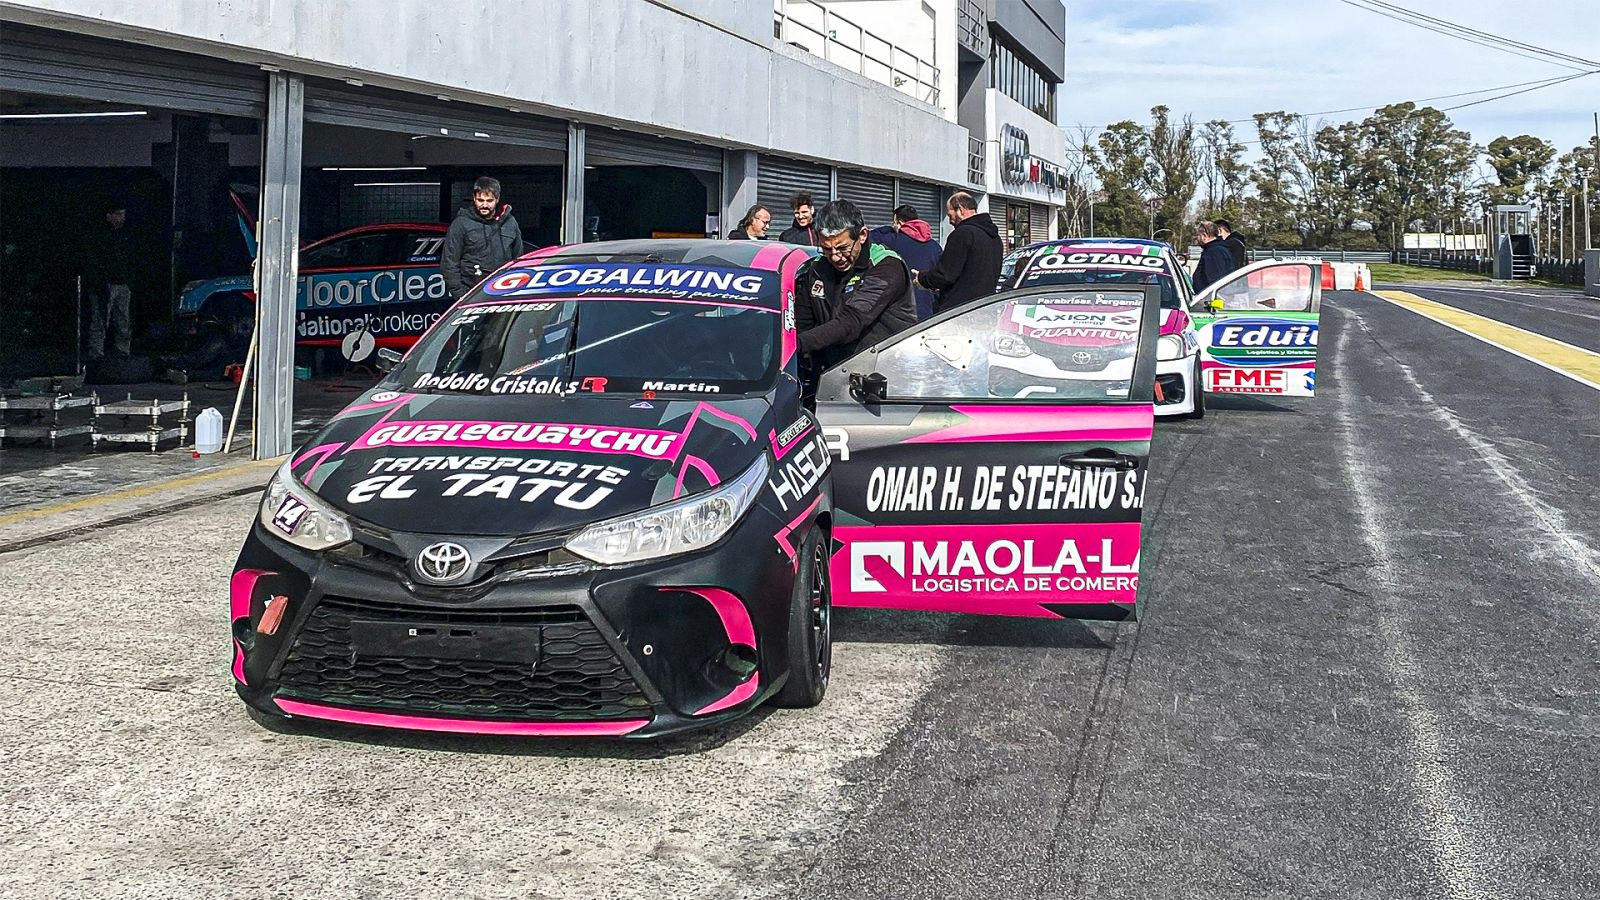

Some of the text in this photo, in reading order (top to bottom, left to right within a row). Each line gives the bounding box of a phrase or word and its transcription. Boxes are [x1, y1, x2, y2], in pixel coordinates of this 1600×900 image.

[412, 237, 444, 255] 77
[1038, 253, 1164, 269] OCTANO
[493, 267, 763, 293] GLOBALWING
[577, 286, 758, 301] your trading partner
[462, 303, 556, 315] VERONESI
[1036, 314, 1106, 323] AXION
[1030, 327, 1137, 341] QUANTIUM
[1213, 370, 1283, 386] FMF
[642, 381, 721, 393] Martin
[367, 456, 630, 484] TRANSPORTE
[346, 473, 614, 510] EL TATU
[866, 465, 1148, 512] OMAR H. DE STEFANO S.
[275, 498, 308, 526] 14
[912, 577, 1019, 592] LOGISTICA
[1024, 577, 1052, 591] DE
